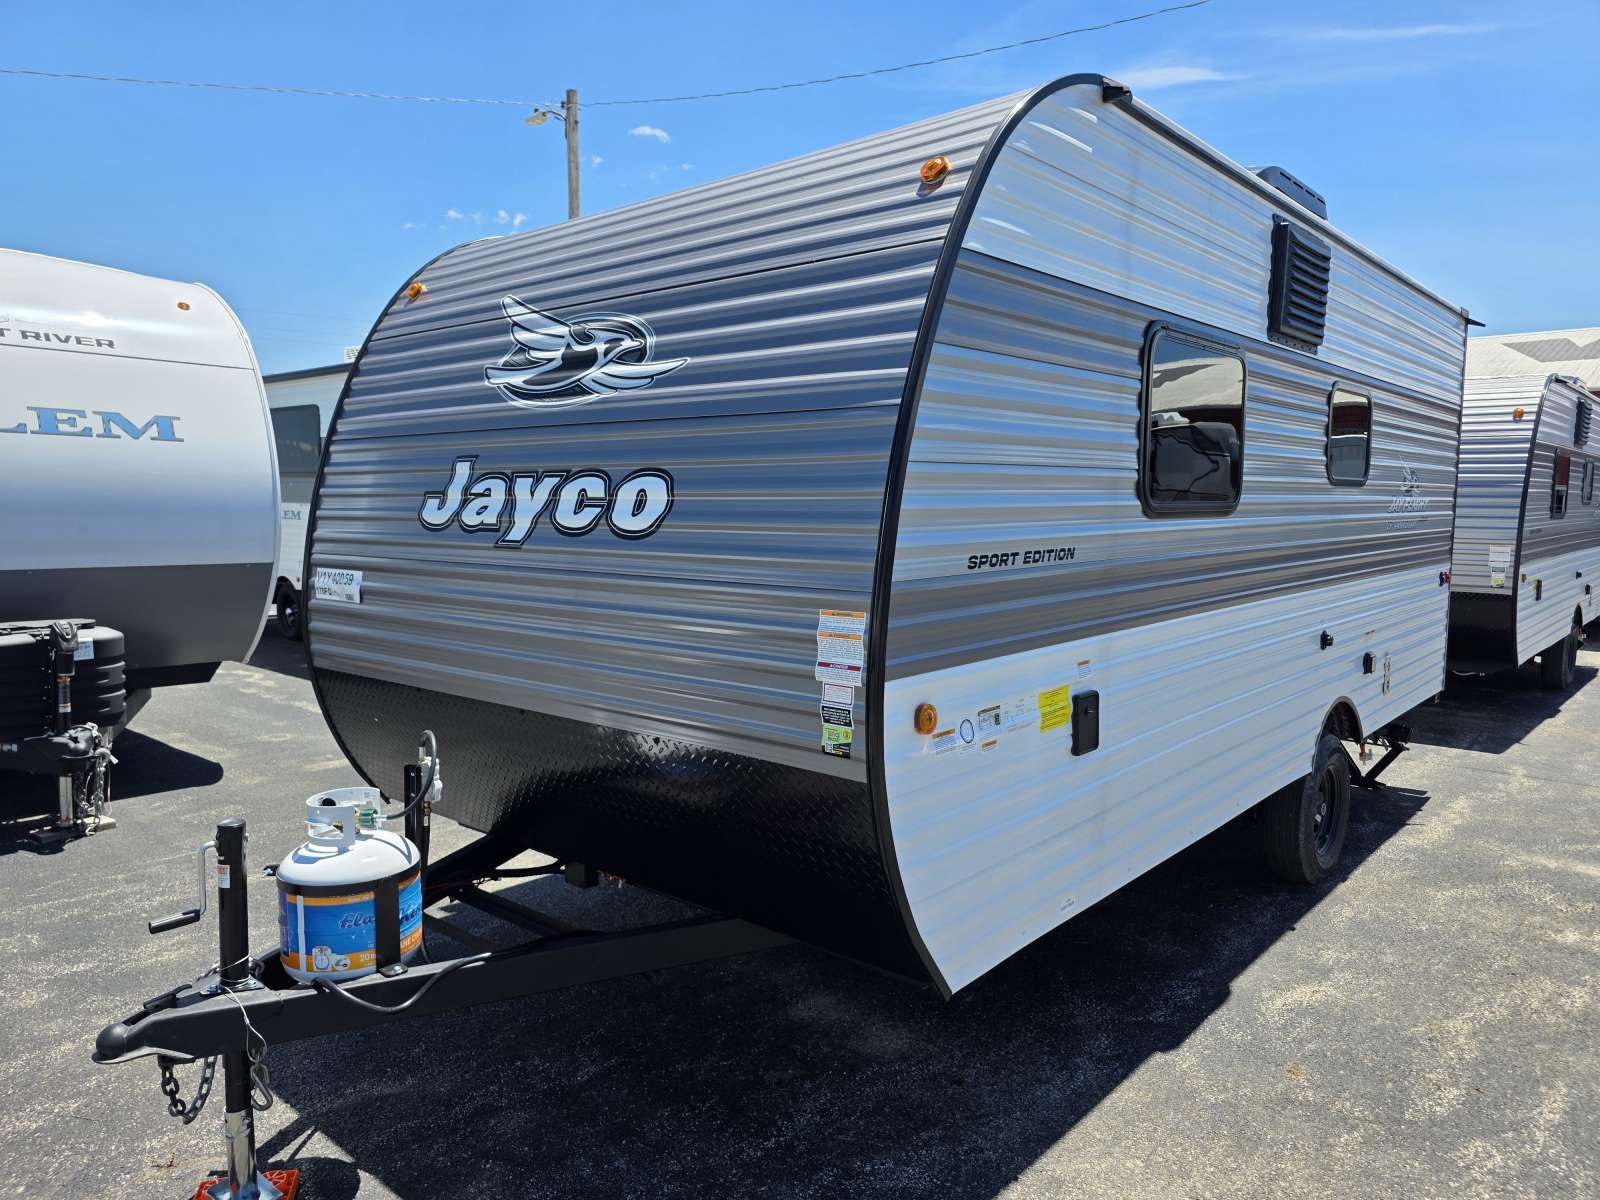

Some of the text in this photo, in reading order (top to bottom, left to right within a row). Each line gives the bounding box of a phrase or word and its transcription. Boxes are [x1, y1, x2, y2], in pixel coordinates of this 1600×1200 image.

[19, 329, 117, 349] RIVER
[418, 455, 674, 550] Jayco
[282, 510, 302, 521] EM
[967, 547, 1076, 570] SPORT EDITION
